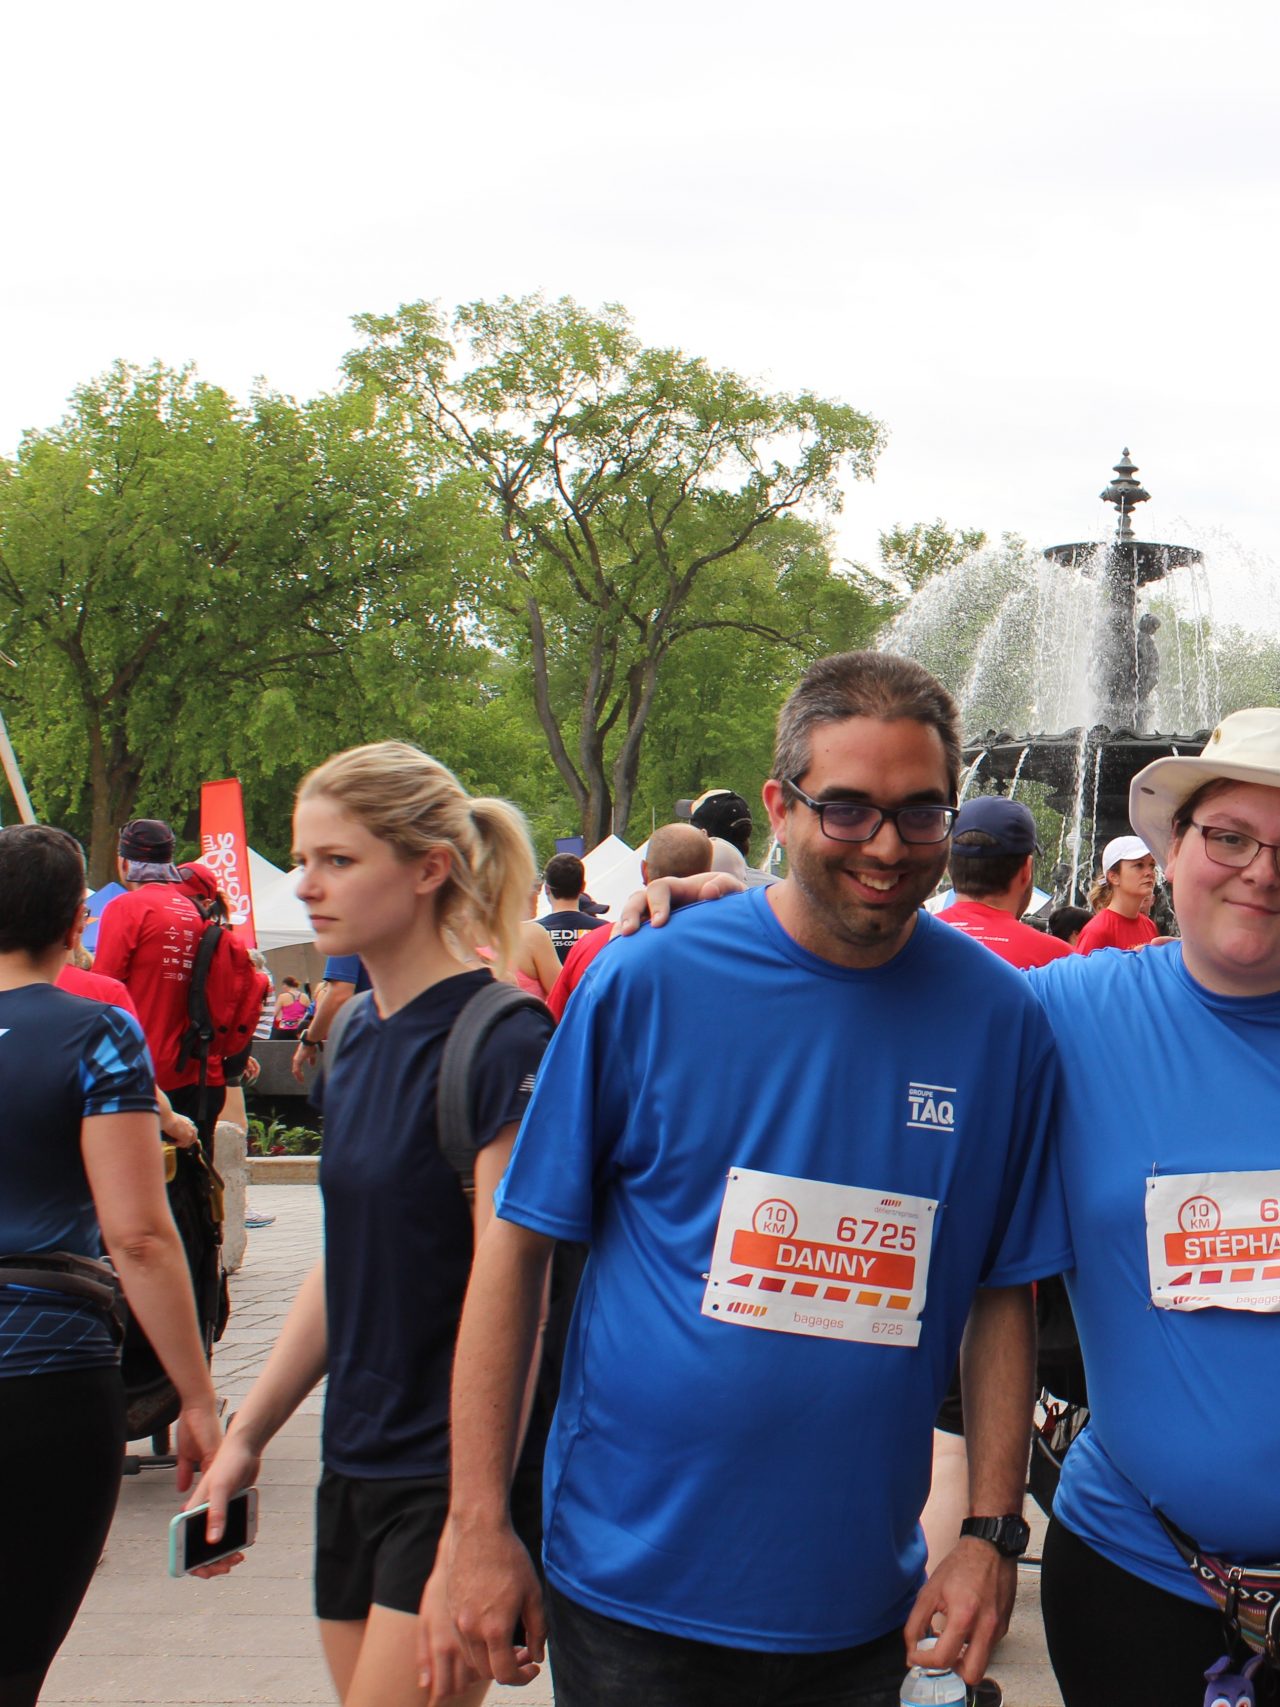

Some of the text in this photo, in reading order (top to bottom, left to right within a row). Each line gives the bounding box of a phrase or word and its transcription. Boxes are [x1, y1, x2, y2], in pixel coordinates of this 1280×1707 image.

[909, 1089, 934, 1098] GROUPE
[909, 1096, 955, 1125] TAQ
[765, 1206, 788, 1223] 10
[1189, 1203, 1210, 1218] 10
[762, 1221, 786, 1236] KM
[1190, 1218, 1211, 1230] KM
[836, 1216, 917, 1252] 6725
[776, 1244, 878, 1279] DANNY
[793, 1311, 904, 1337] bagages 6725
